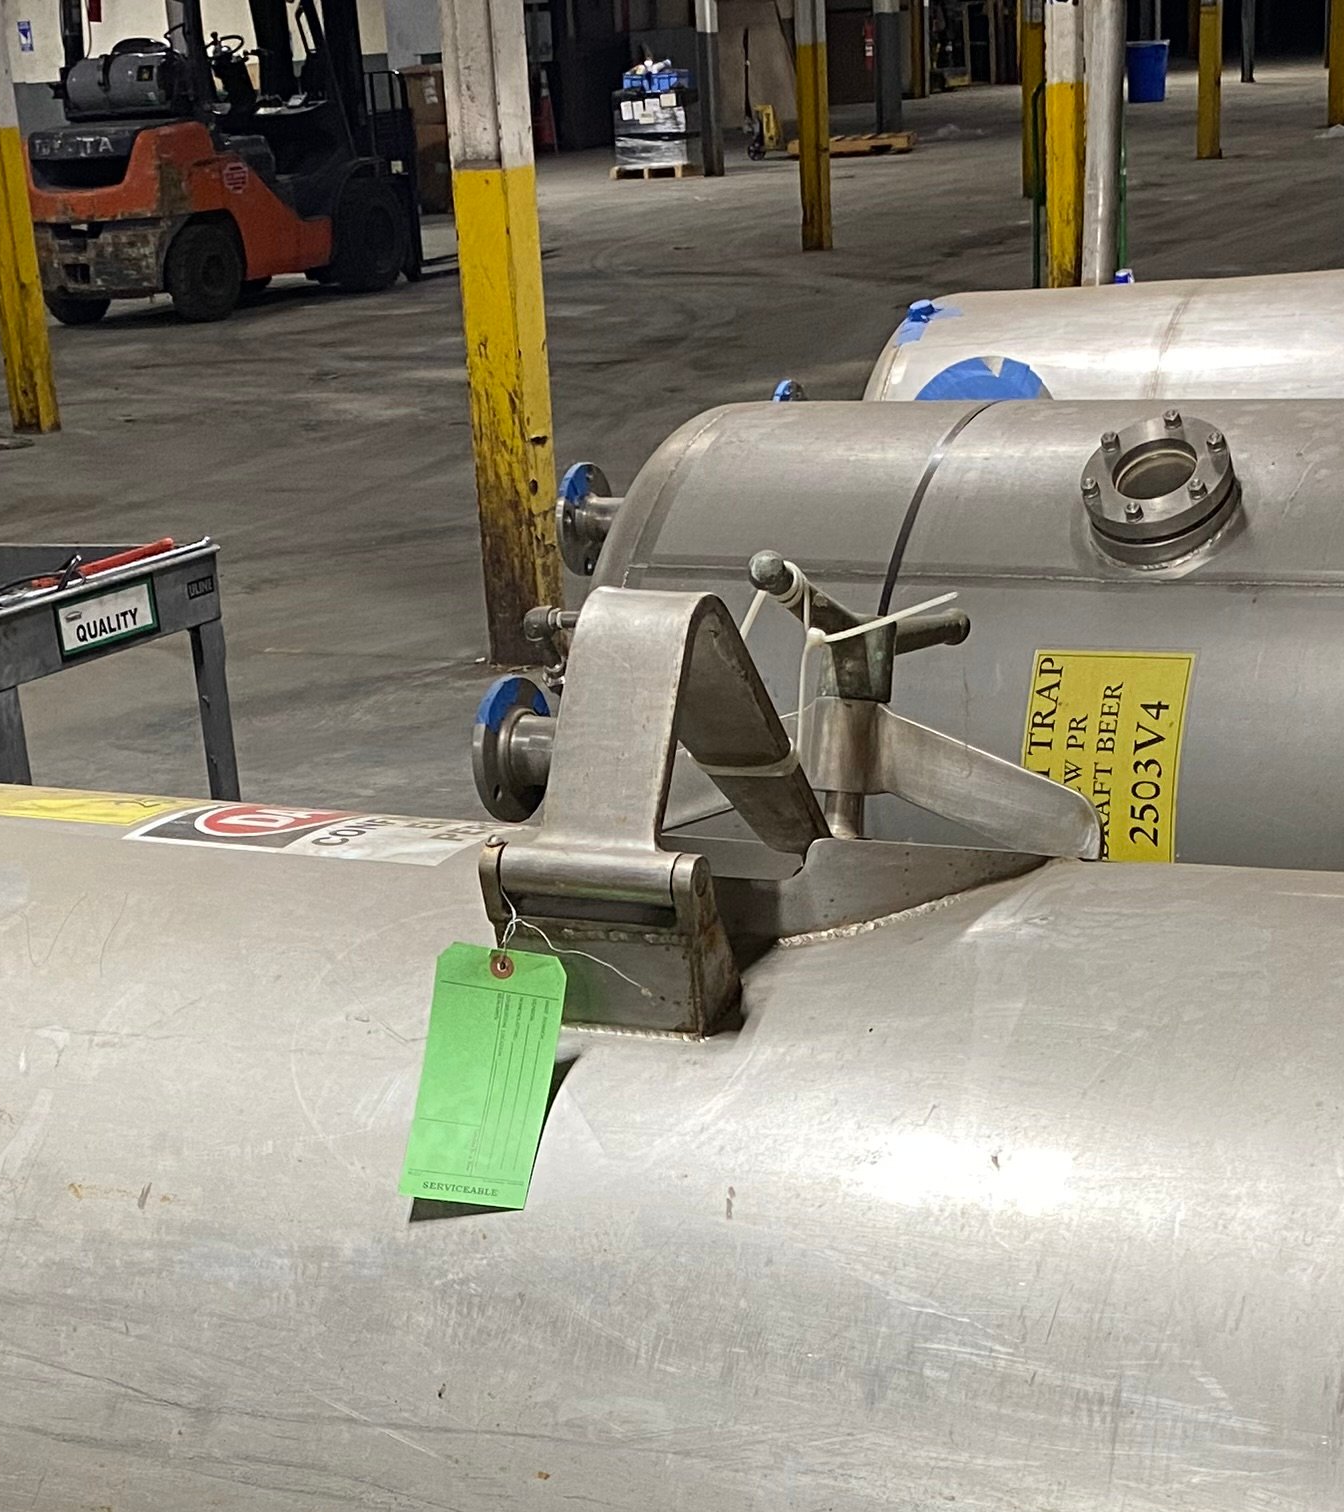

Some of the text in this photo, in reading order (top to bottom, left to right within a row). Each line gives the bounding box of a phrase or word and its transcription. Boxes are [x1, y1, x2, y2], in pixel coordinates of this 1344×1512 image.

[76, 608, 138, 642] QUALITY
[1027, 656, 1064, 756] TRAP
[1067, 713, 1088, 751] PR
[1096, 681, 1124, 755] BEER
[1128, 700, 1170, 848] 2503V4
[422, 1181, 499, 1197] SERVICEABLE
